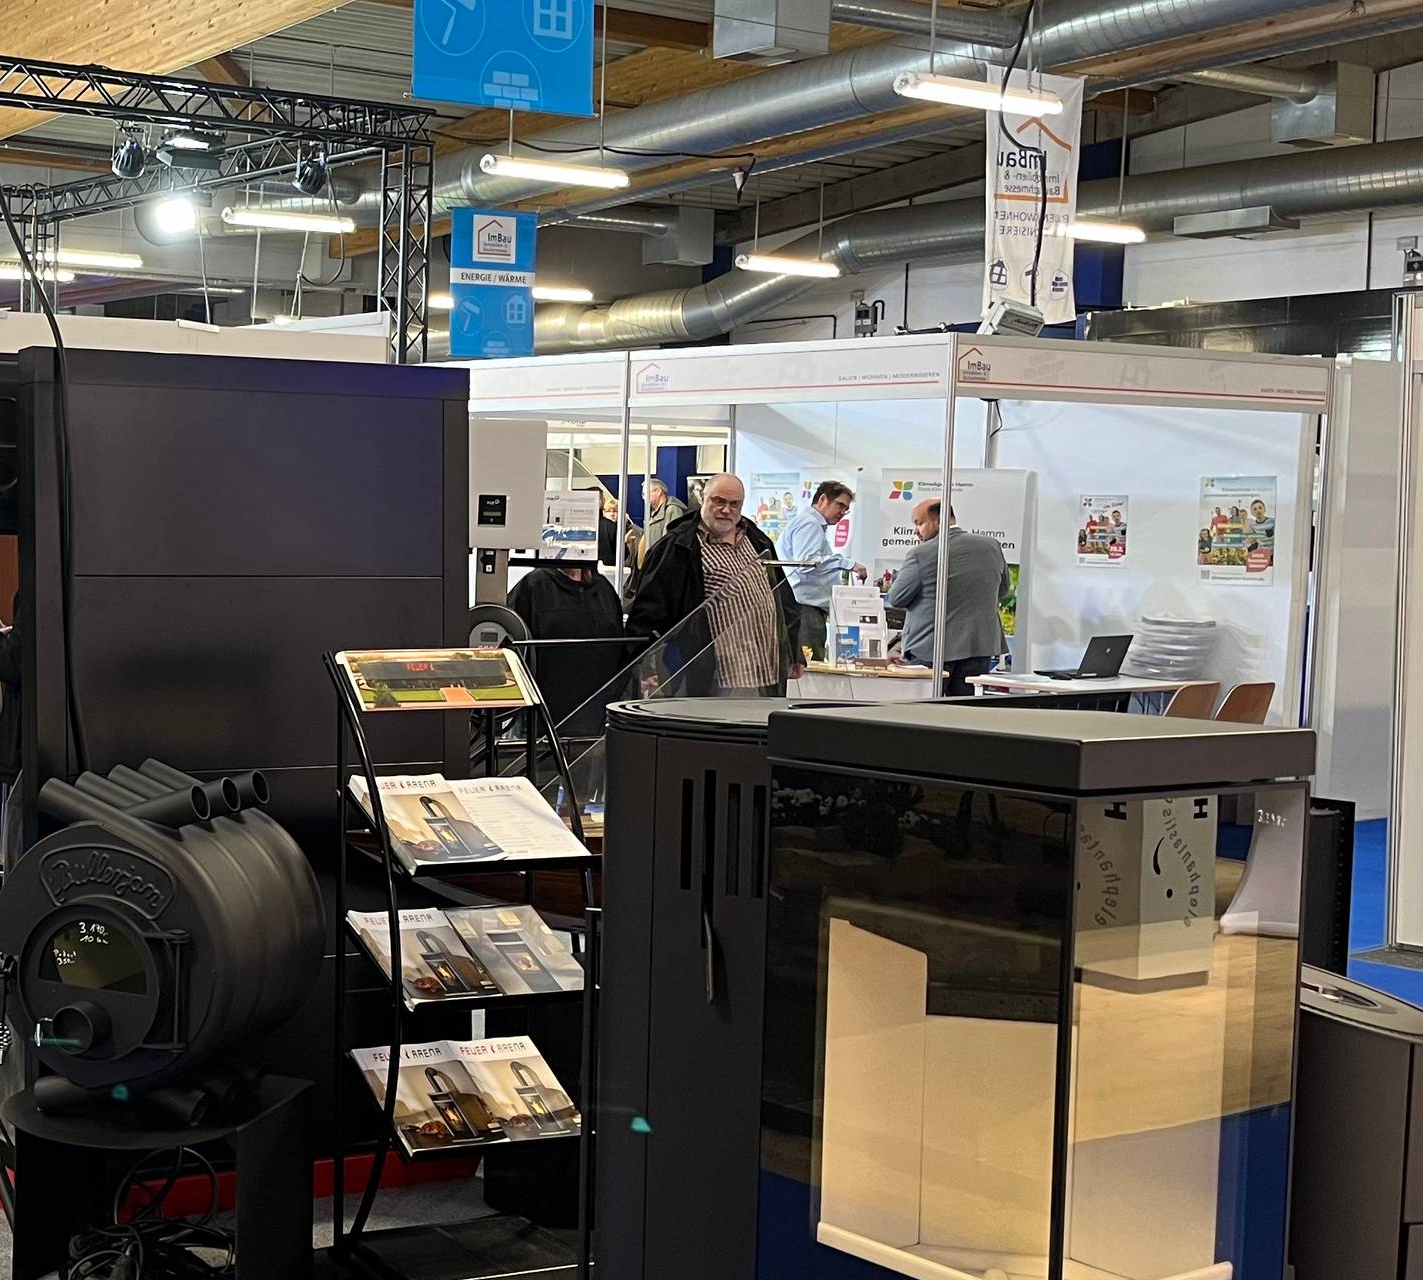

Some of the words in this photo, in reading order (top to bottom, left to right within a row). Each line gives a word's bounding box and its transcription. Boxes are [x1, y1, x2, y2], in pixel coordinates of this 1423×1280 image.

[487, 233, 512, 244] ImBau
[461, 272, 492, 282] ENERGIE
[499, 273, 527, 284] WÄRME
[967, 360, 992, 371] ImBau
[645, 373, 670, 384] ImBau
[406, 779, 437, 790] ARENA
[402, 913, 434, 922] ARENA
[411, 1047, 442, 1058] ARENA
[459, 1045, 487, 1057] FEUER
[495, 1041, 526, 1052] ARENA
